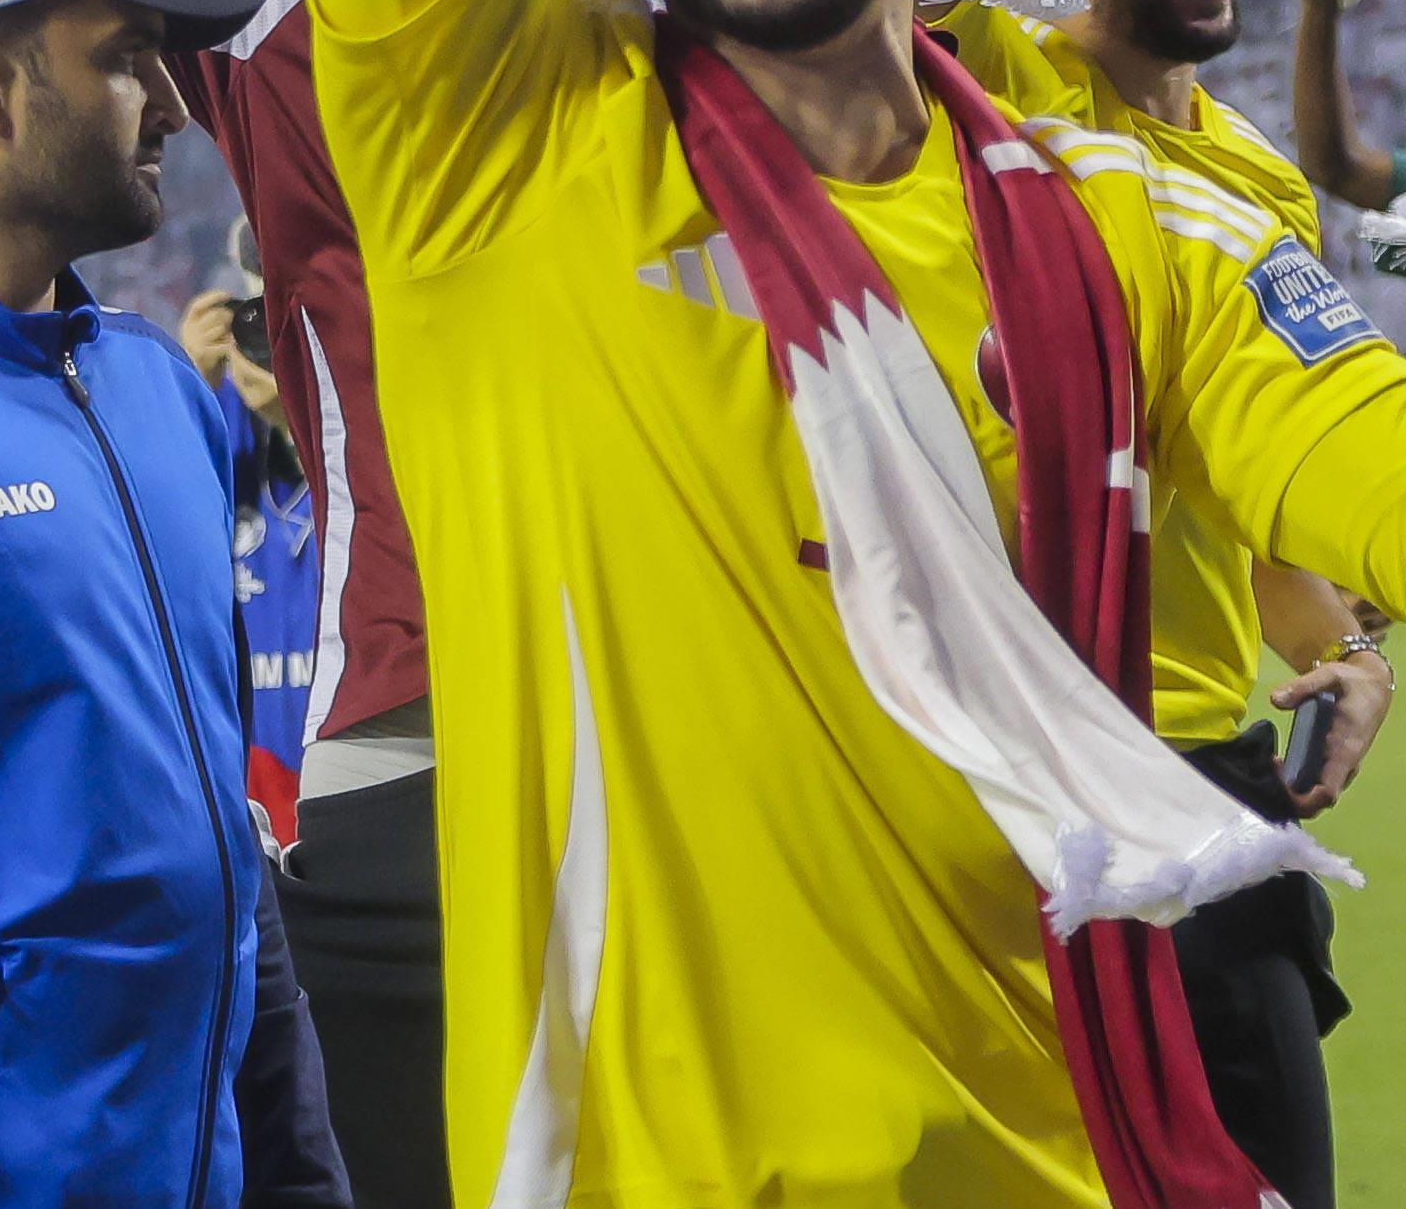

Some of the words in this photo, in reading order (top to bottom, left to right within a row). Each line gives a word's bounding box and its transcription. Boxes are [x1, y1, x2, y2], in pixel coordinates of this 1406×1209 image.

[1261, 251, 1316, 281] FOOTB
[1272, 263, 1334, 305] UNITE
[1326, 307, 1355, 325] FIFA
